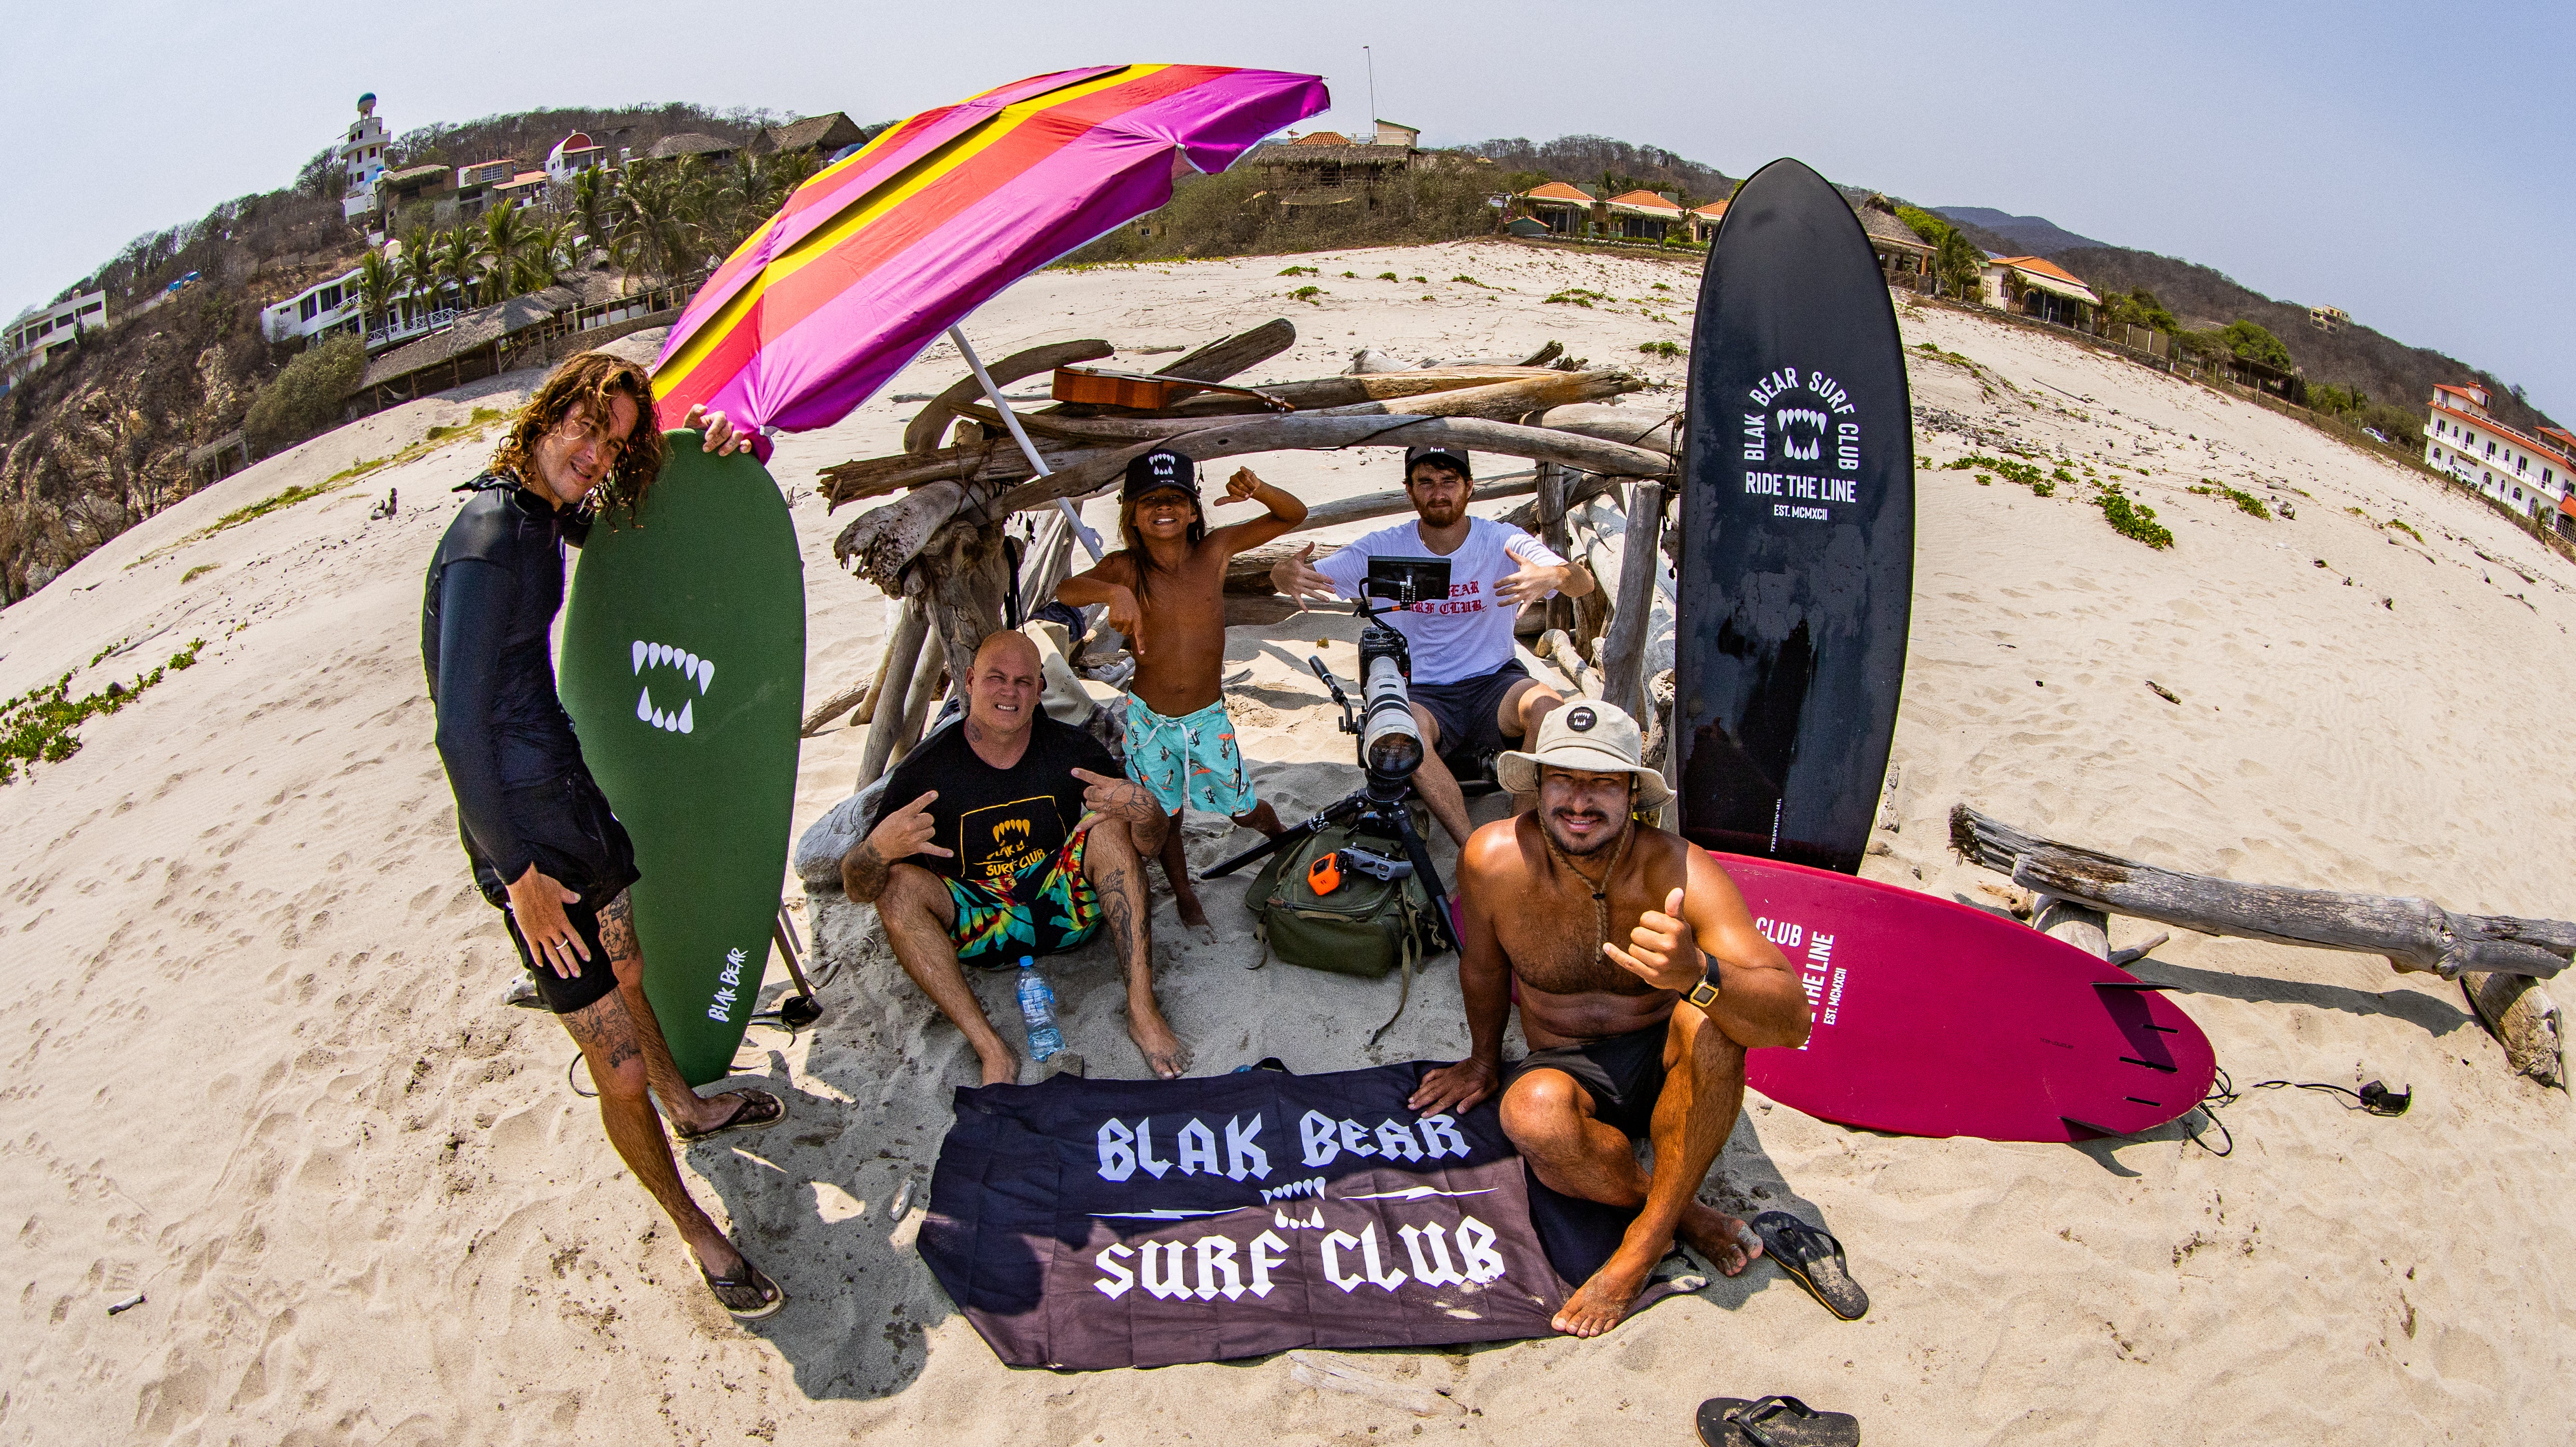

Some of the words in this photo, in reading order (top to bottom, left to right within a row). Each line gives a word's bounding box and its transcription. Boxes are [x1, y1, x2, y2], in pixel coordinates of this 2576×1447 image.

[1749, 368, 1799, 407] BEAR
[1809, 371, 1855, 414] SURF
[1744, 414, 1765, 461] BLAK
[1838, 423, 1859, 470] CLUB
[1745, 472, 1782, 496] RIDE
[1786, 475, 1817, 499] THE
[1821, 478, 1856, 503] LINE
[1774, 504, 1790, 517] EST.
[1792, 505, 1827, 520] MCMXCII
[1439, 600, 1482, 615] CLUB
[1449, 581, 1480, 597] EAR
[1019, 849, 1045, 868] CLUB
[1755, 916, 1803, 947] CLUB
[719, 947, 748, 986] BEAR
[1806, 931, 1835, 972] LINE
[708, 987, 738, 1023] BLAK
[1828, 967, 1847, 1006] MCMXCII
[1823, 1007, 1838, 1025] EST.
[1096, 1111, 1273, 1182] BLAK
[1299, 1109, 1471, 1168] BEAR
[1093, 1229, 1290, 1302] SURF
[1320, 1215, 1506, 1294] CLUB
